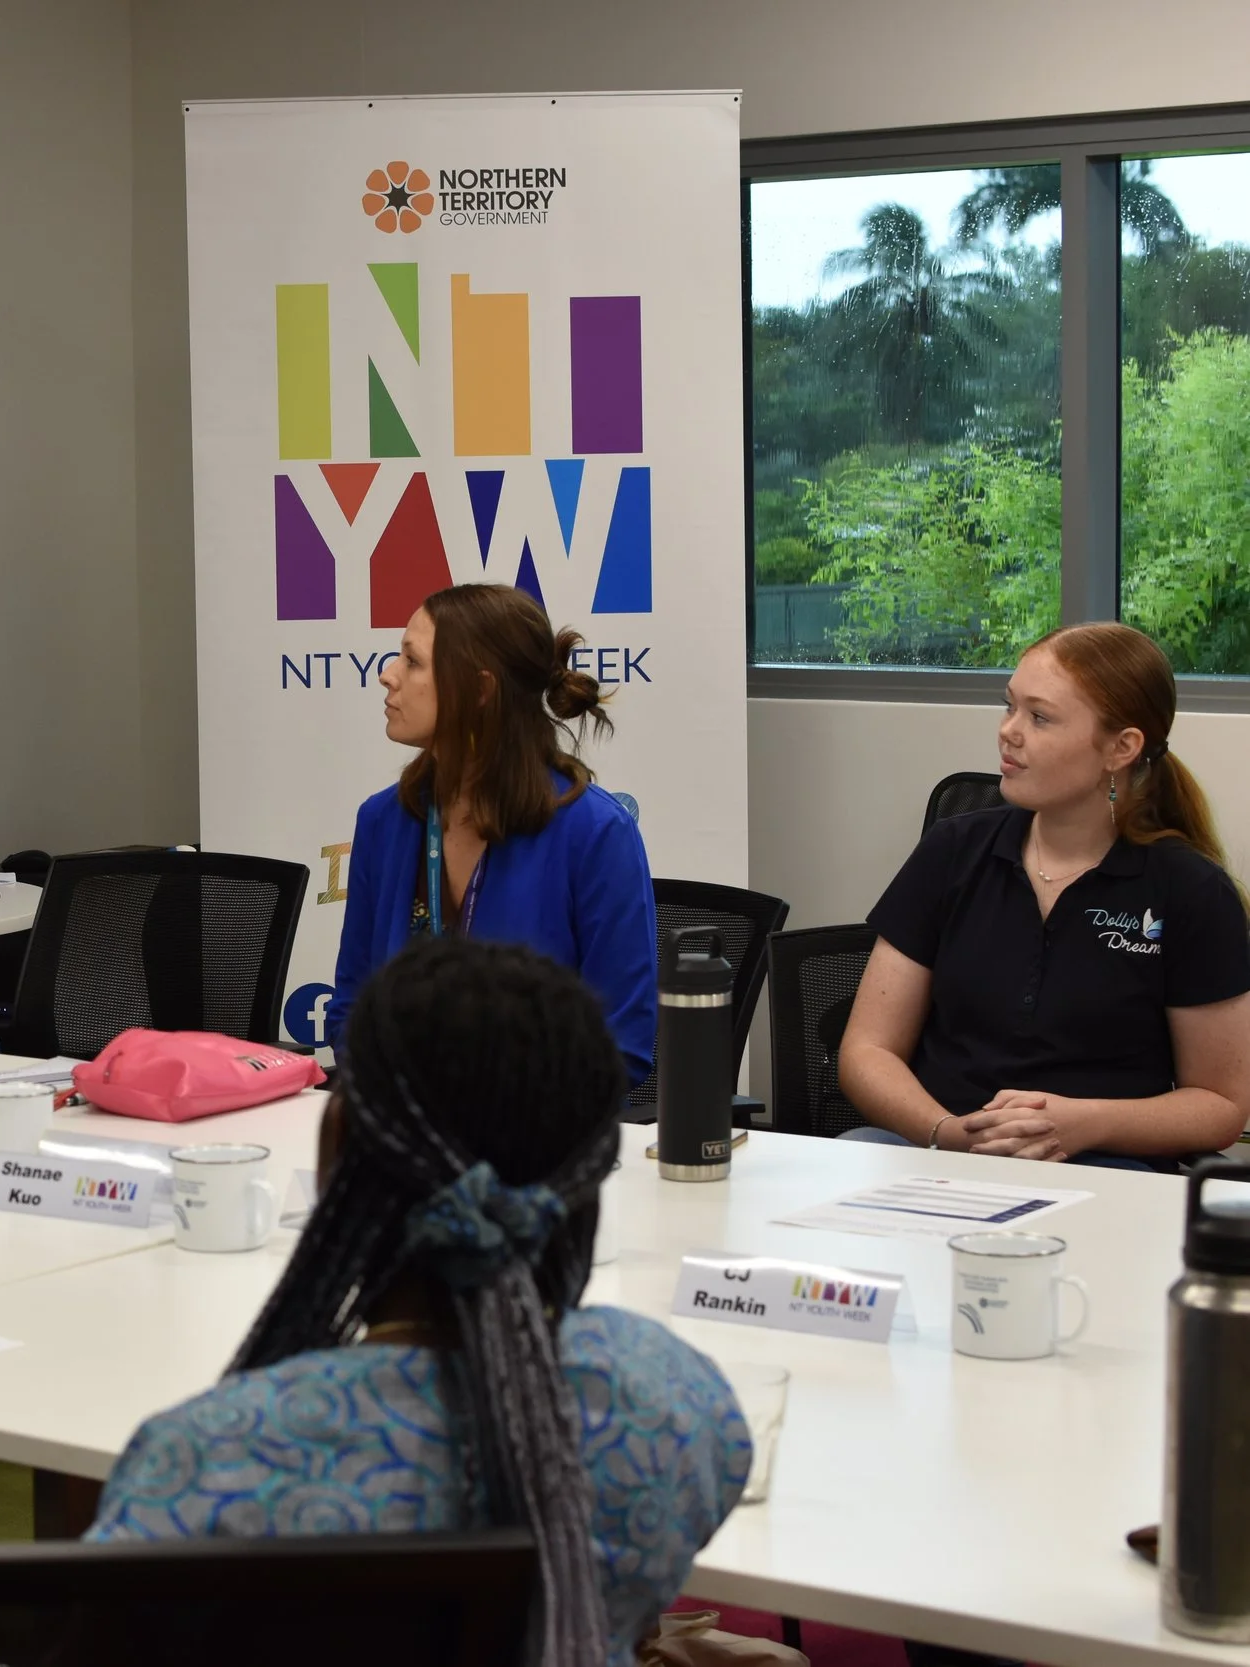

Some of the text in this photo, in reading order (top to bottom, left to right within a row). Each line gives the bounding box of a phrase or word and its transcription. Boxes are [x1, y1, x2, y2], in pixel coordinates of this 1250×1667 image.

[439, 168, 566, 189] NORTHERN
[439, 190, 553, 211] TERRITORY
[439, 211, 548, 225] GOVERNMENT
[281, 653, 341, 689] NT
[570, 647, 652, 683] EEK
[1084, 908, 1140, 933] Dolly's
[1098, 931, 1161, 954] Dream
[706, 1143, 730, 1155] YETI
[1, 1161, 63, 1181] Shanae
[8, 1188, 42, 1205] Kuo
[693, 1290, 766, 1317] Rankin
[789, 1302, 871, 1322] NT YOUTH WEEK
